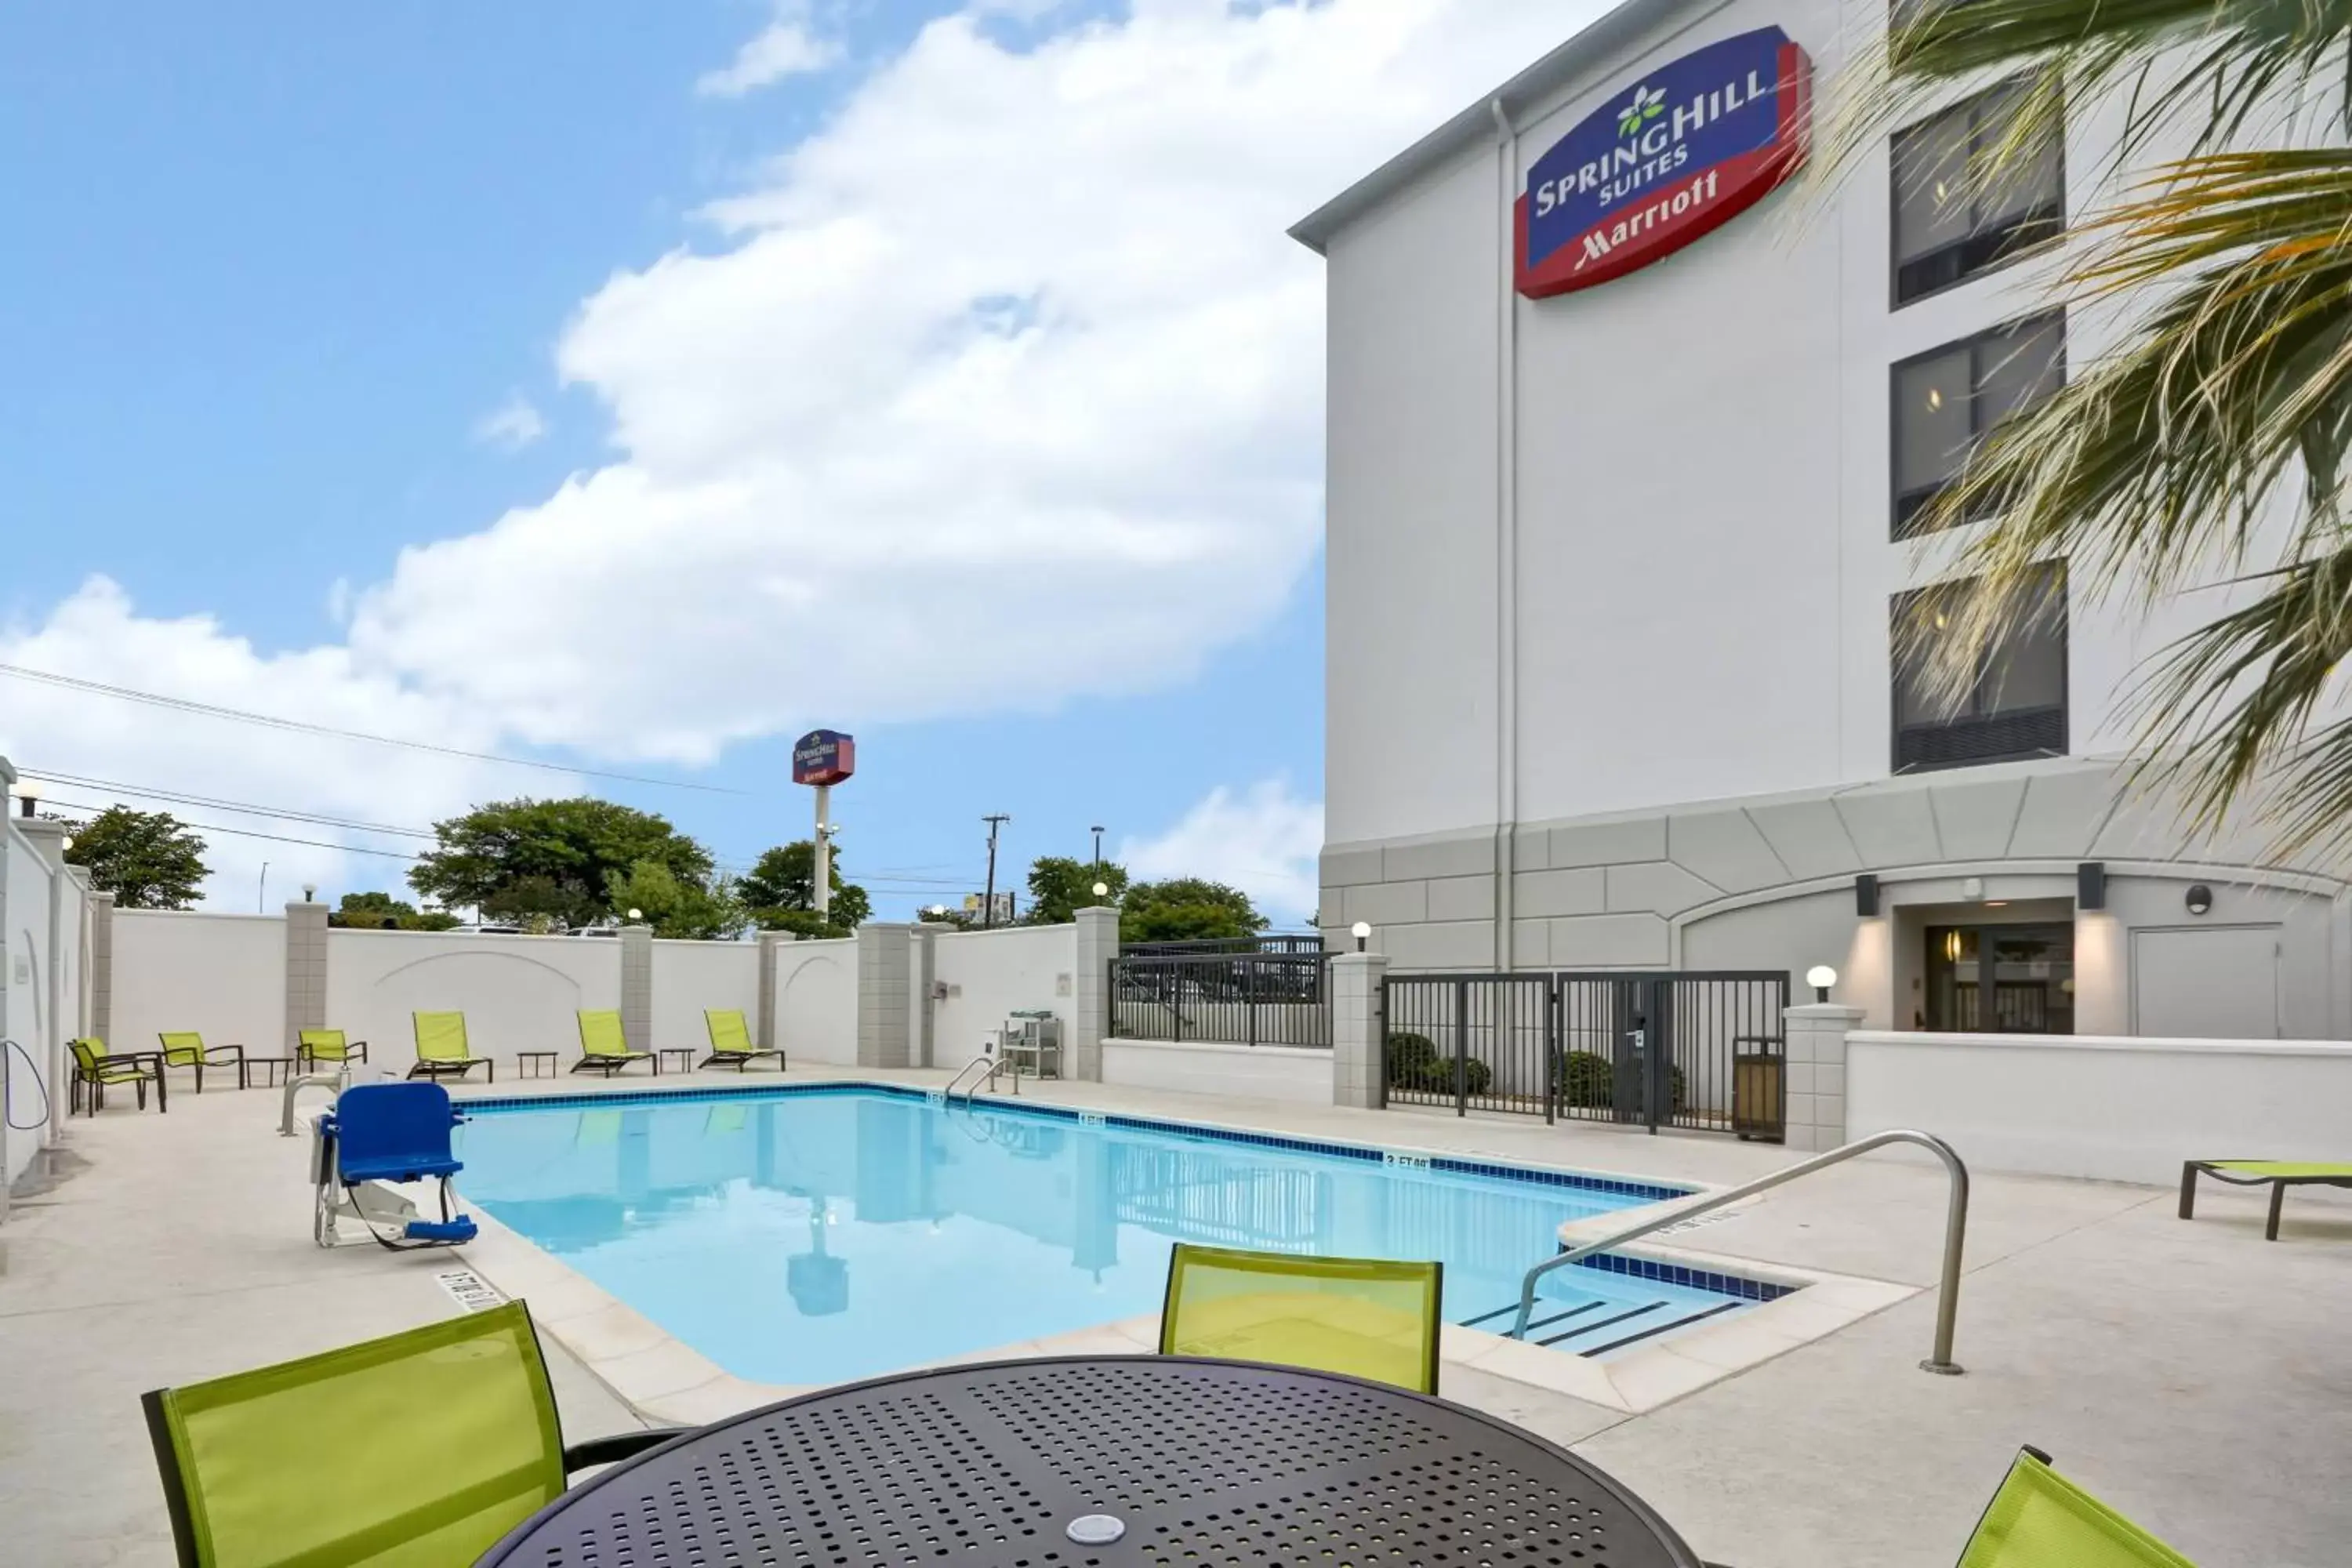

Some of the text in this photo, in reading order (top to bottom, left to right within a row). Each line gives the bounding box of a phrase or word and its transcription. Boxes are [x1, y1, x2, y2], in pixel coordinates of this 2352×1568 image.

[1536, 70, 1766, 218] SPRINGHILL
[1599, 143, 1689, 207] SUITES
[1574, 169, 1719, 270] Marriott
